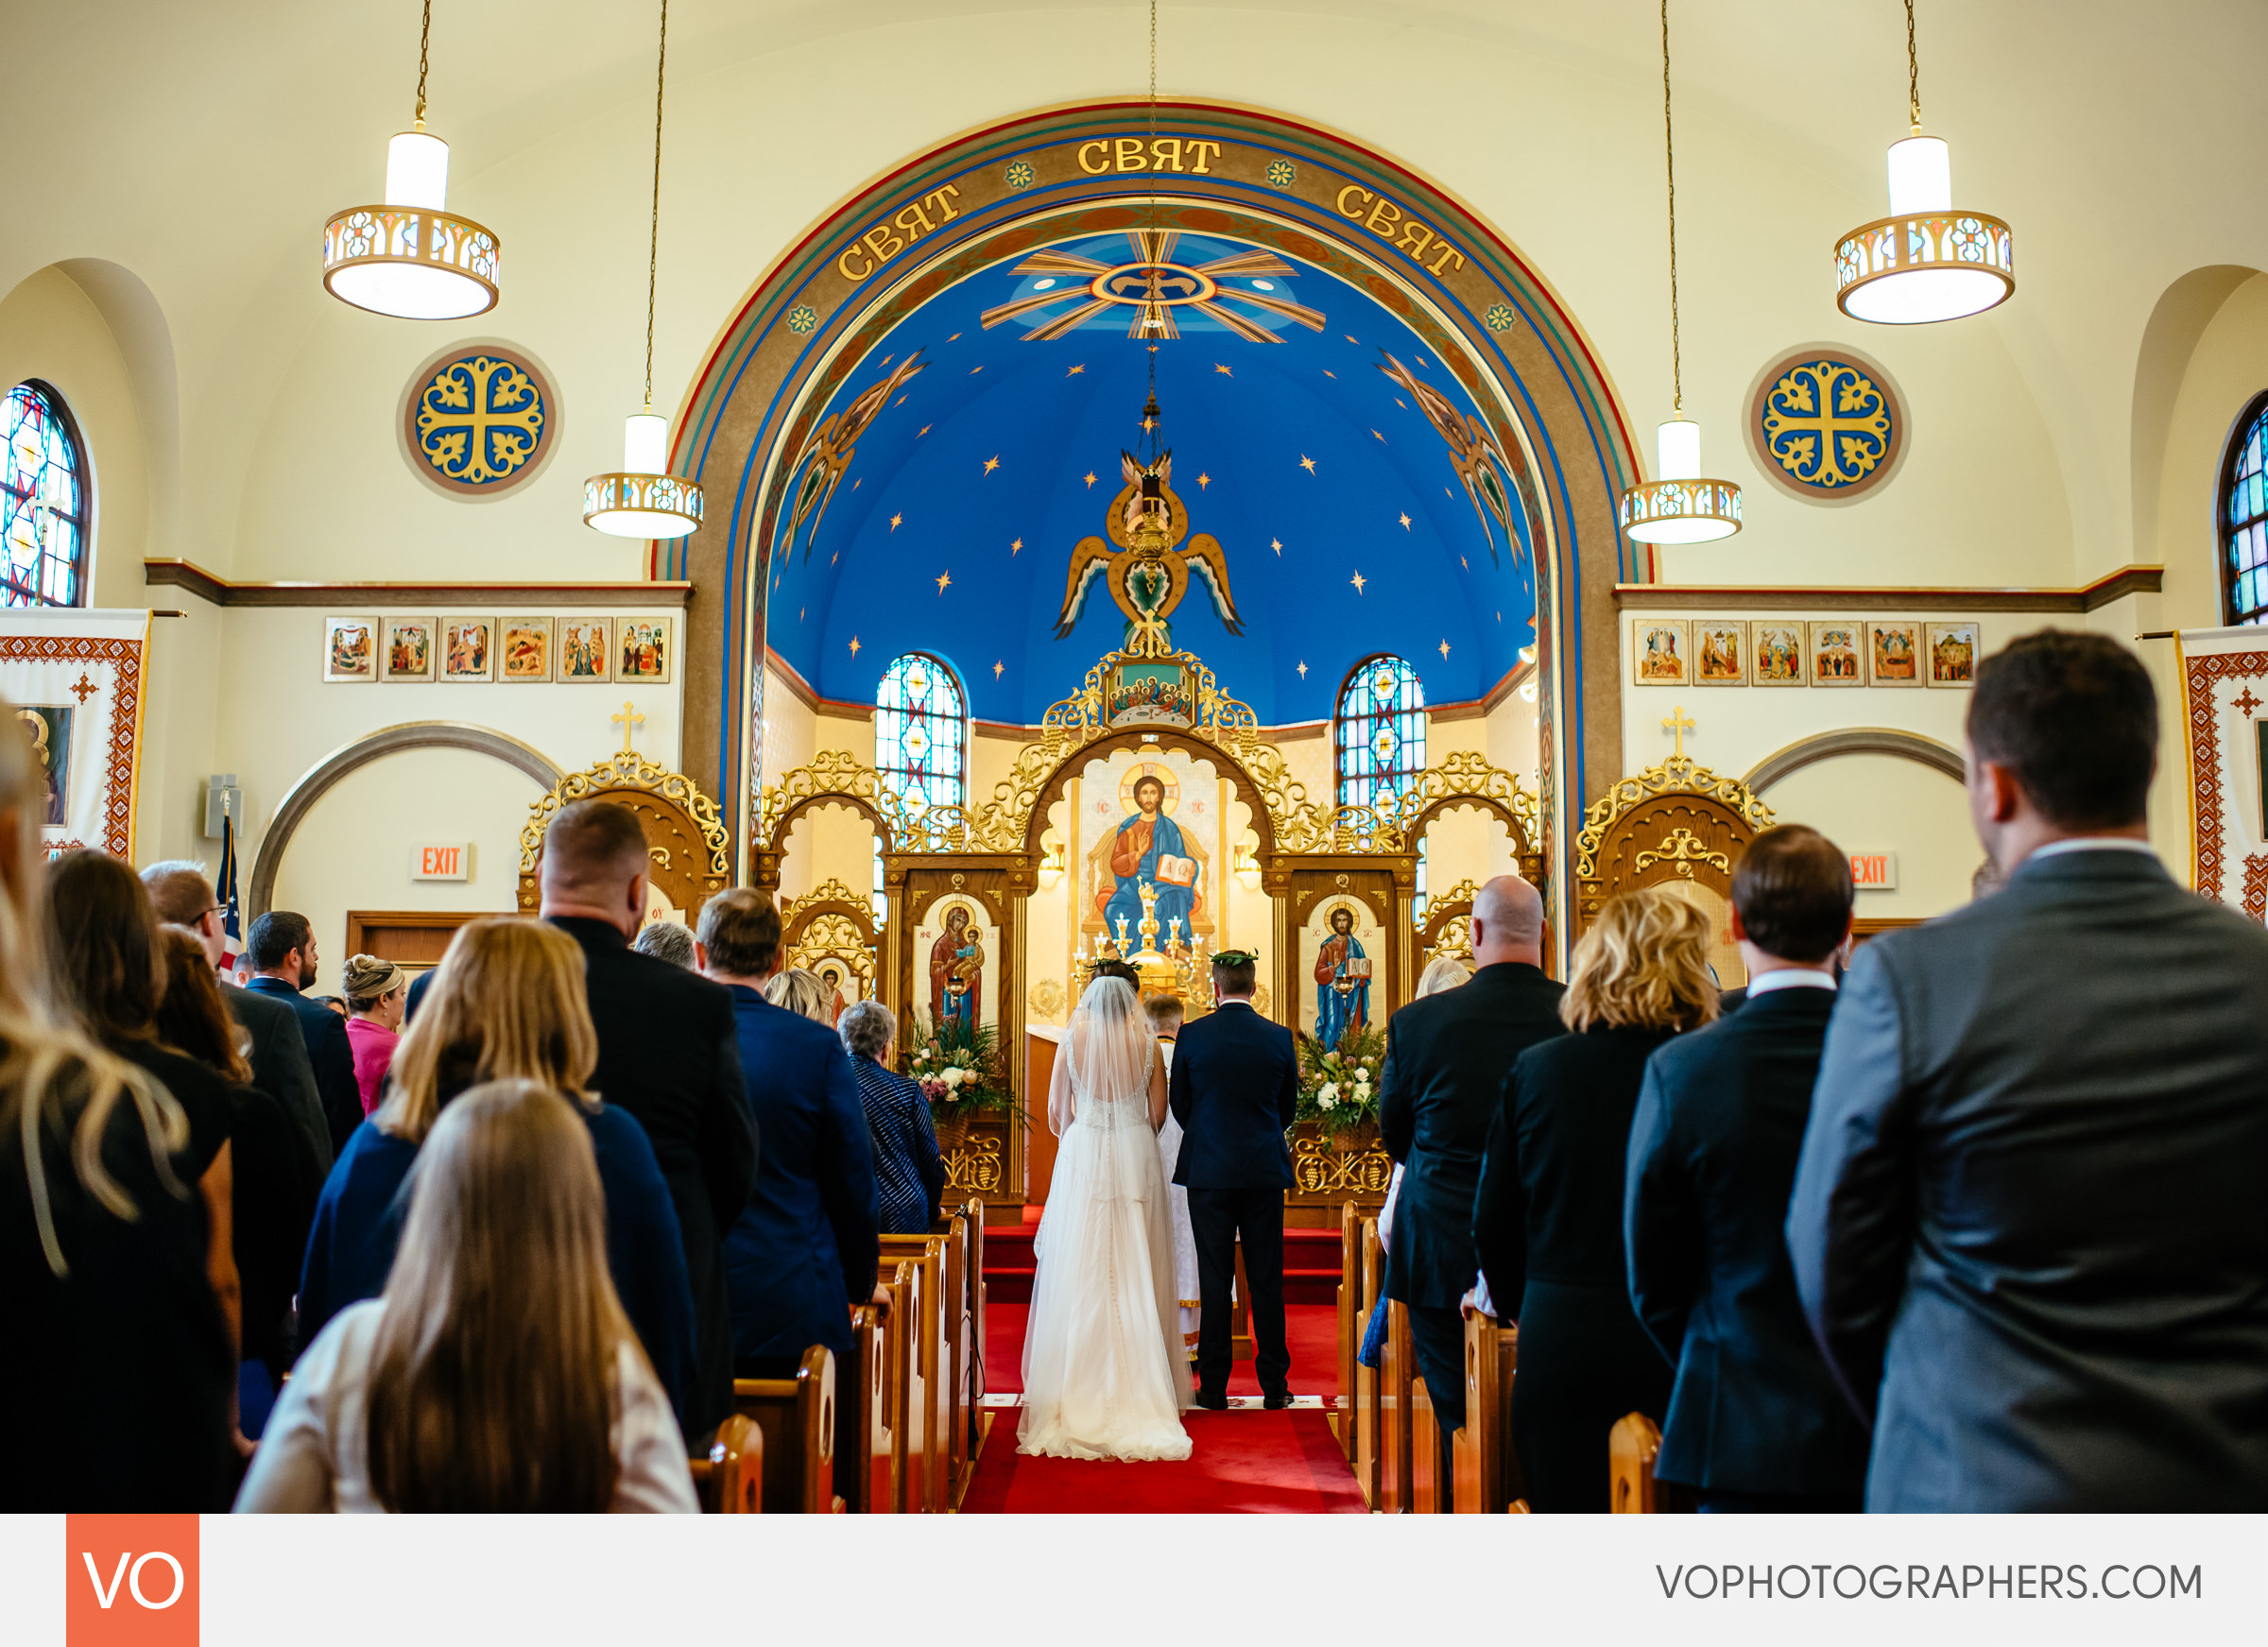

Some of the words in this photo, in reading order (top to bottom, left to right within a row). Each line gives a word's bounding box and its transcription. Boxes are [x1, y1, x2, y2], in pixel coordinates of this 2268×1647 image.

[838, 182, 960, 282] СВЯТ
[1077, 138, 1222, 175] СВЯТ
[1335, 184, 1466, 277] СВЯТ
[422, 847, 461, 875] EXIT
[1850, 855, 1888, 884] EXIT
